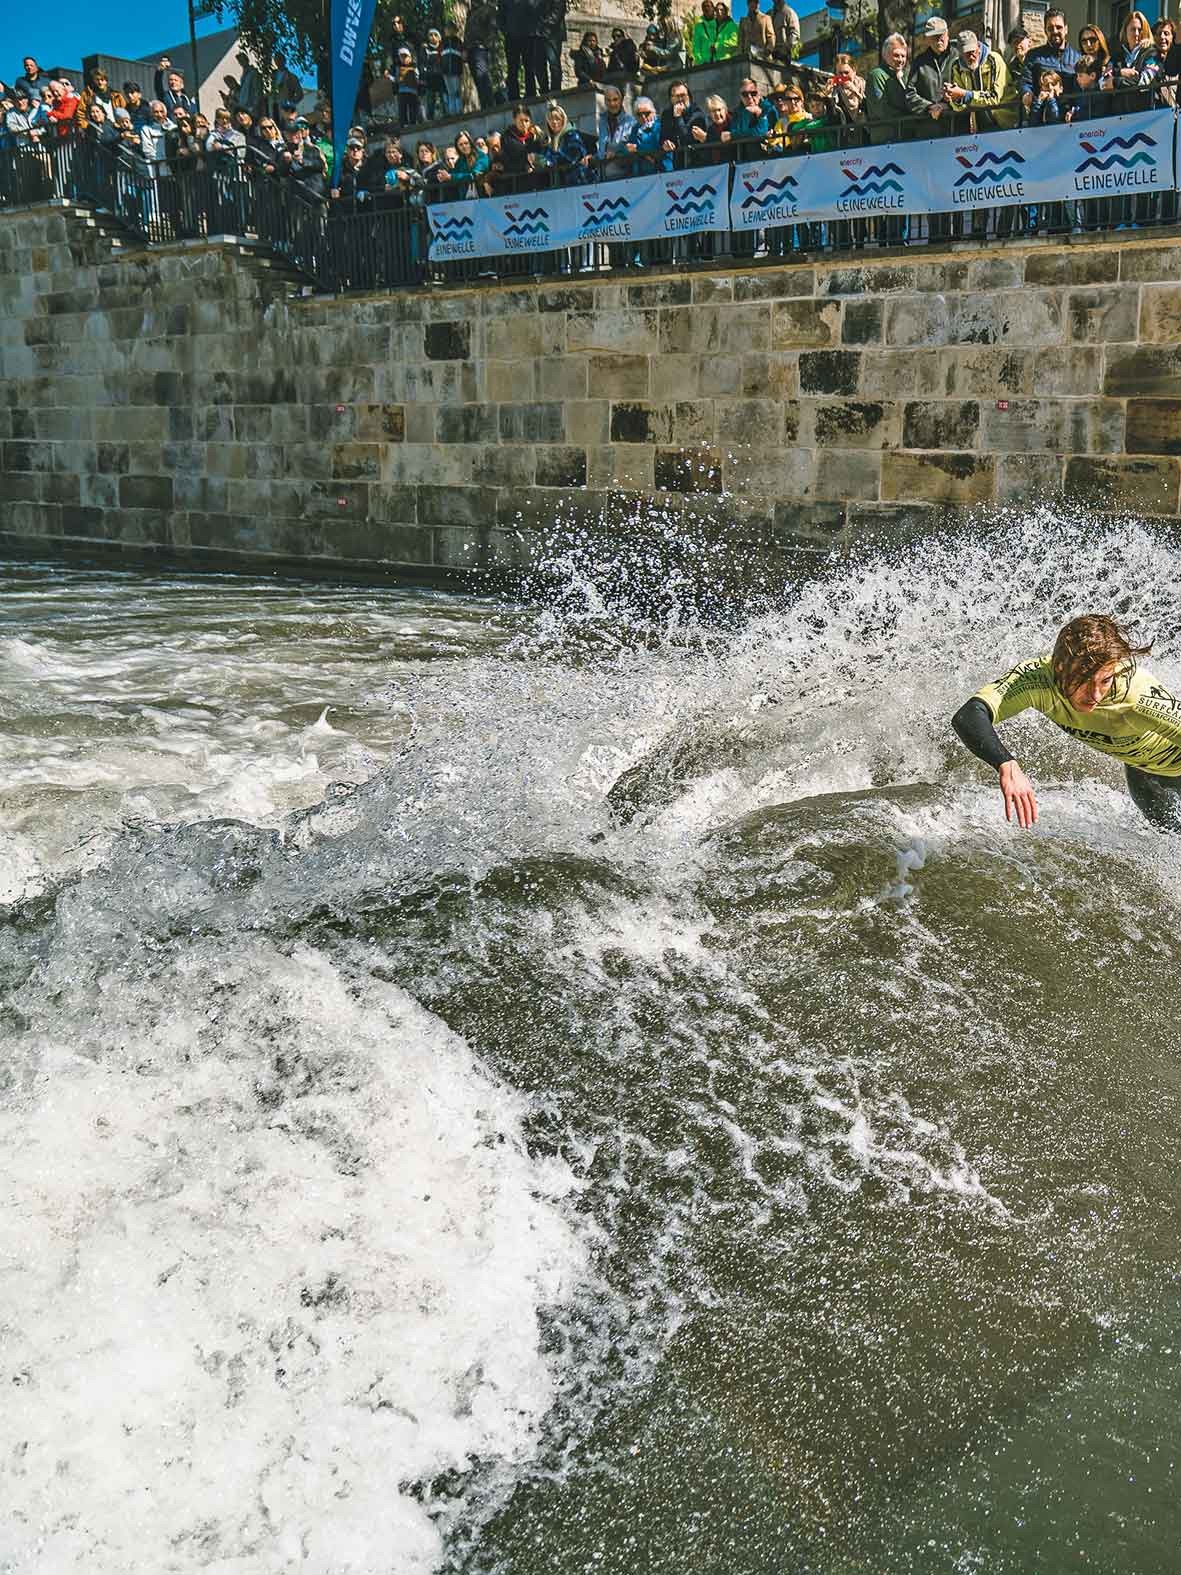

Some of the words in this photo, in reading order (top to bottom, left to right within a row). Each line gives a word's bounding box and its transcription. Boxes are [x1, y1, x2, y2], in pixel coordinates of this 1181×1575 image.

[1075, 168, 1158, 191] LEINEWELLE
[952, 182, 1025, 204] LEINEWELLE
[836, 195, 905, 213] LEINEWELLE
[664, 212, 715, 232] LEINEWELLE
[742, 205, 799, 224] LEINEWELLE
